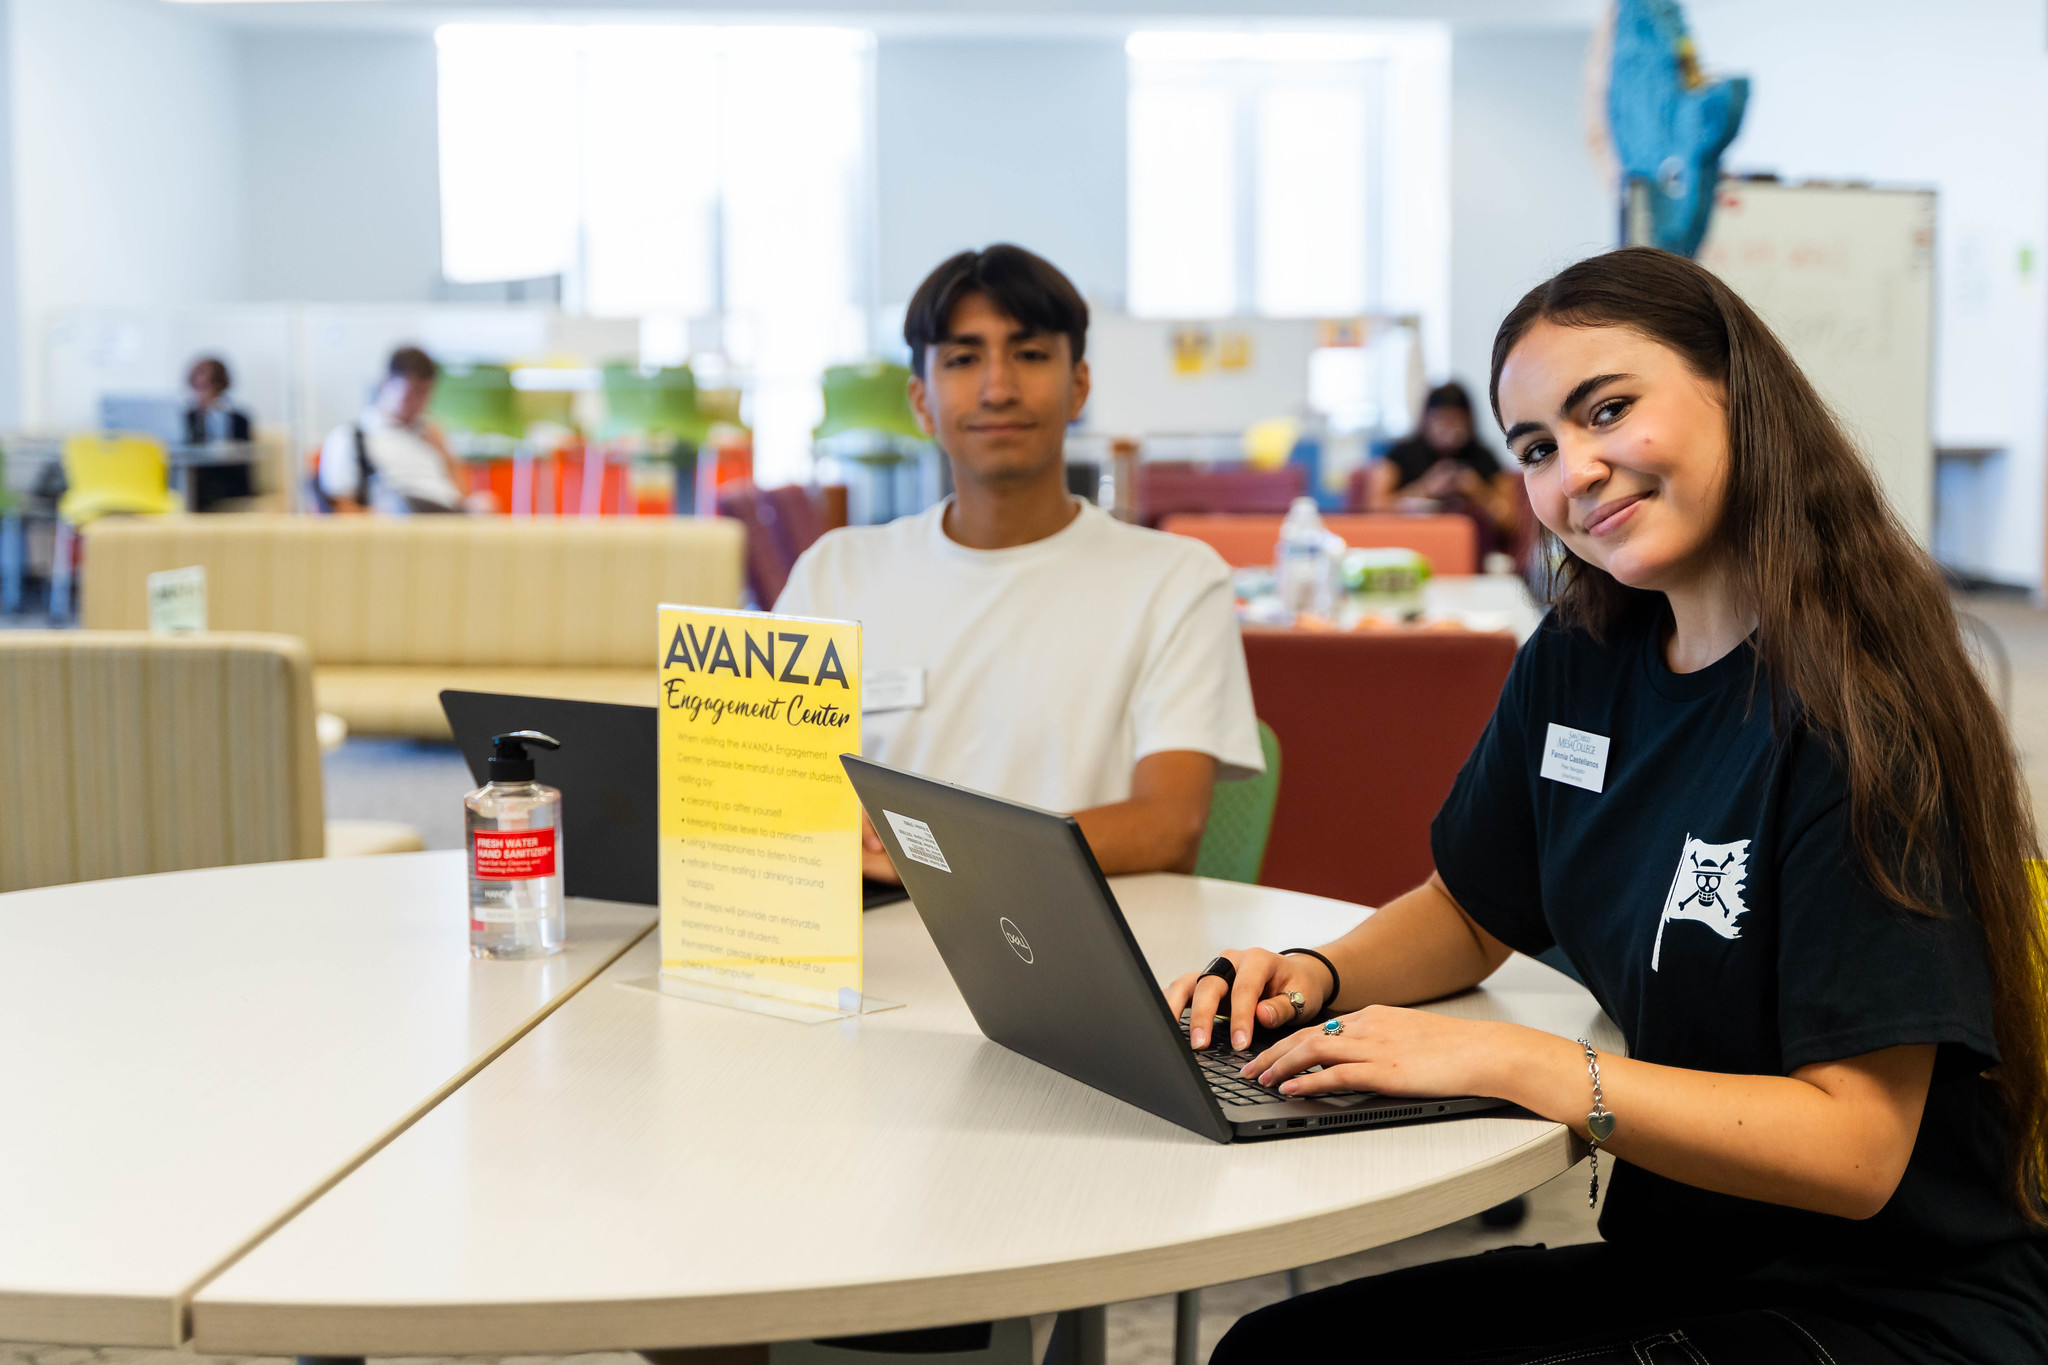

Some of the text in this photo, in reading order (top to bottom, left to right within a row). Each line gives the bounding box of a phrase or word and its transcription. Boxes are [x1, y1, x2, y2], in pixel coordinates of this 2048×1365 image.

[663, 623, 850, 690] AVANZA
[664, 678, 850, 728] Engagement Center
[678, 732, 828, 760] When visiting the AVANZA Engagement
[678, 774, 702, 787] visiting
[705, 757, 732, 770] please
[733, 760, 745, 771] be
[745, 762, 774, 775] mindful
[776, 766, 785, 776] of
[786, 768, 807, 780] other
[809, 770, 842, 784] students
[686, 796, 782, 819] cleaning up after yourself
[505, 837, 539, 849] WATER
[686, 816, 814, 844] keeping noise level to a minimum
[477, 849, 502, 860] HAND
[686, 837, 823, 868] using headphones to listen to music
[712, 860, 730, 873] from
[731, 864, 756, 879] eating
[763, 869, 794, 886] drinking
[795, 876, 825, 890] around
[681, 895, 820, 931] These steps will provide an enjoyable
[681, 918, 724, 934] experience
[725, 924, 736, 936] for
[737, 928, 746, 938] all
[1006, 931, 1029, 949] DELL
[727, 948, 752, 960] please
[754, 952, 769, 966] sign
[770, 953, 778, 964] in
[779, 956, 786, 967] &
[787, 958, 801, 969] out
[802, 961, 811, 972] at
[812, 964, 826, 975] our
